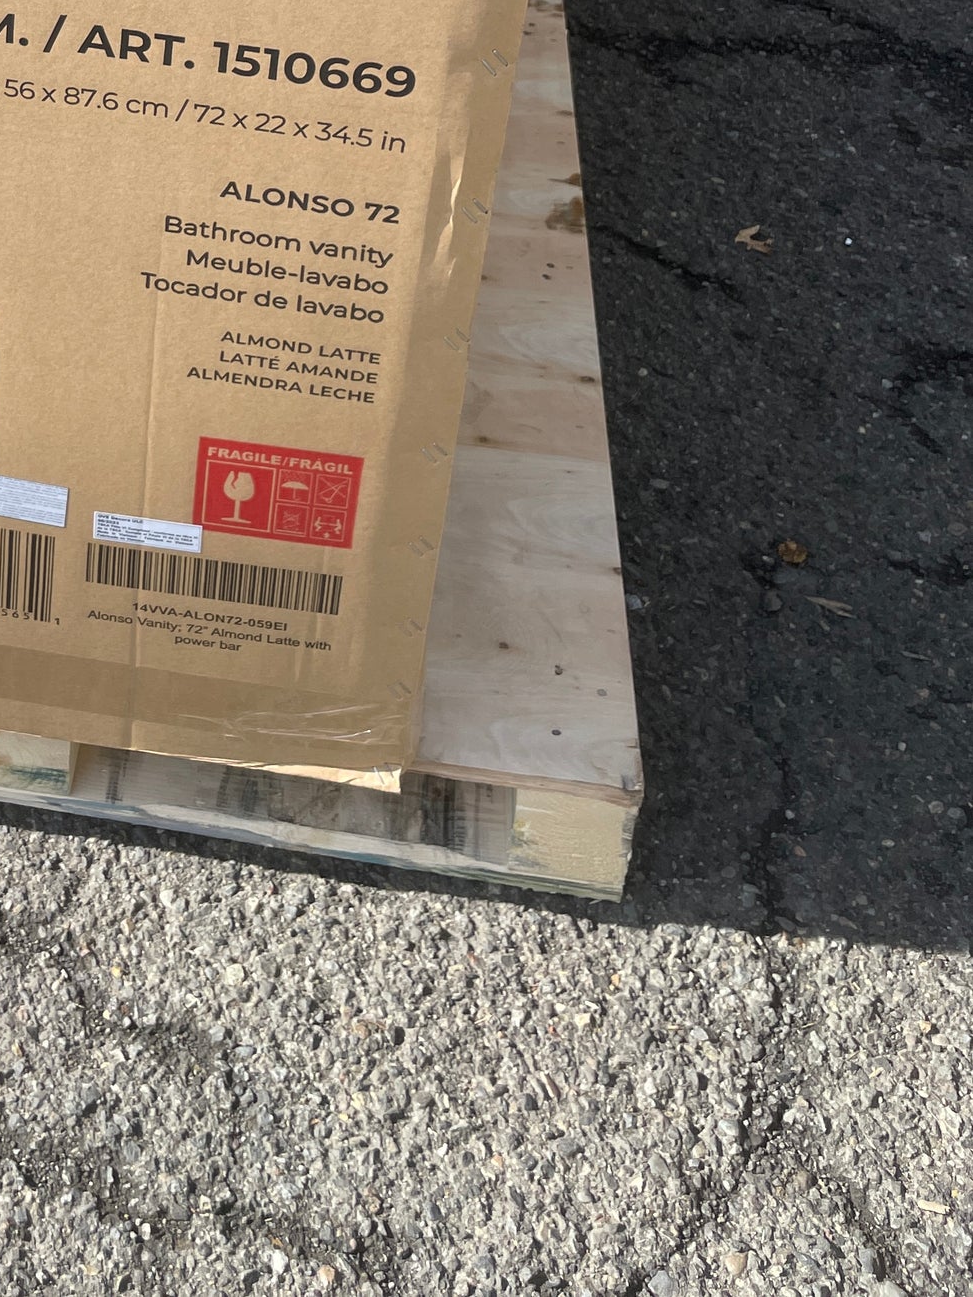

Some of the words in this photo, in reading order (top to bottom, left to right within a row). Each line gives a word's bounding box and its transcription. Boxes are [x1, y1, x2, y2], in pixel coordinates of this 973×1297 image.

[43, 14, 68, 53] /
[77, 24, 195, 70] ART.
[212, 41, 417, 98] 1510669
[3, 78, 36, 100] 56
[41, 87, 57, 103] x
[63, 86, 119, 111] 87.6
[125, 96, 169, 118] cm
[175, 98, 190, 122] /
[193, 103, 226, 126] 72
[232, 112, 248, 130] x
[254, 113, 287, 135] 22
[292, 121, 309, 139] x
[314, 121, 373, 148] 34.5
[380, 130, 406, 154] in
[220, 181, 355, 217] ALONSO
[364, 202, 401, 225] 72
[164, 215, 301, 252] Bathroom
[309, 240, 394, 269] vanity
[186, 249, 389, 295] Meuble-lavabo
[141, 271, 247, 303] Tocador
[253, 290, 288, 309] de
[296, 295, 384, 324] lavabo
[220, 330, 313, 354] ALMOND
[319, 345, 382, 365] LATTE
[220, 350, 280, 370] LATTÉ
[285, 361, 378, 384] AMANDE
[186, 366, 303, 394] ALMENDRA
[309, 384, 375, 404] LECHE
[87, 610, 133, 625] Alonso
[137, 616, 182, 633] Vanity;
[186, 623, 209, 634] 72"
[211, 627, 263, 643] Almond
[267, 635, 300, 647] Latte
[305, 640, 332, 652] with
[132, 602, 288, 631] 14VVA-ALON72-059EI
[174, 635, 216, 648] power
[220, 640, 242, 652] bar
